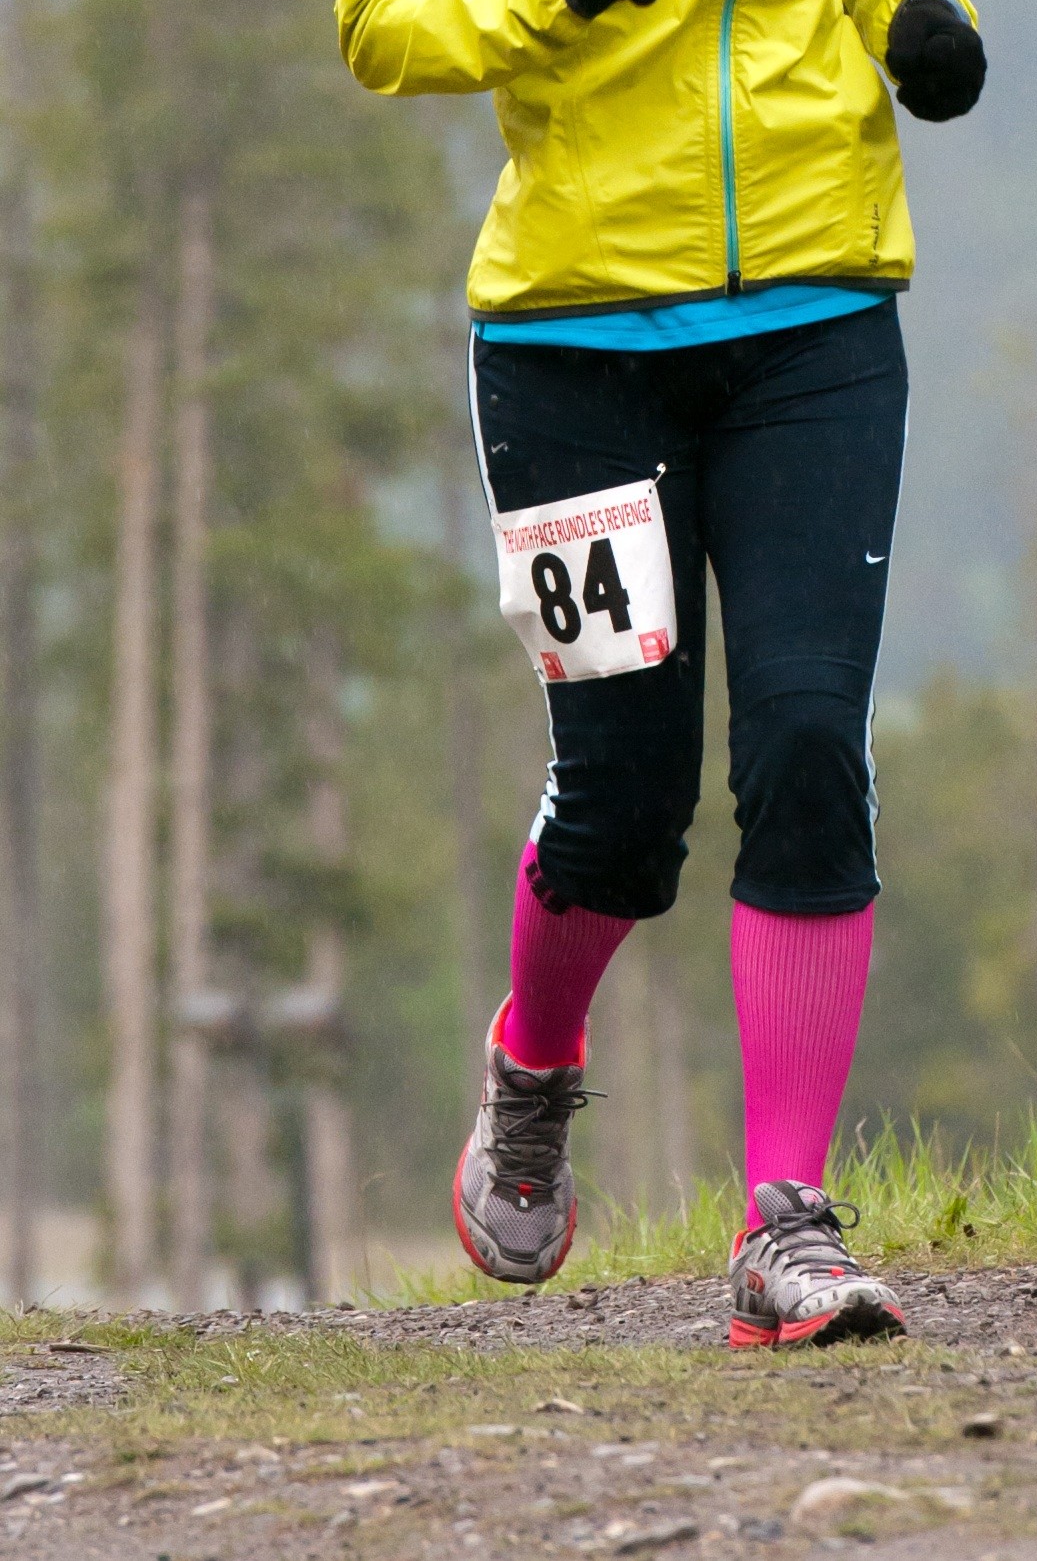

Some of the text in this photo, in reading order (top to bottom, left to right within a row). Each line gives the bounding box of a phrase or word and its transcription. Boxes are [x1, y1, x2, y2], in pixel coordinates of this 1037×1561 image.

[533, 522, 557, 548] FACE
[555, 510, 605, 543] RUNDLE'S
[605, 498, 652, 530] REVENGE
[531, 538, 633, 644] 84
